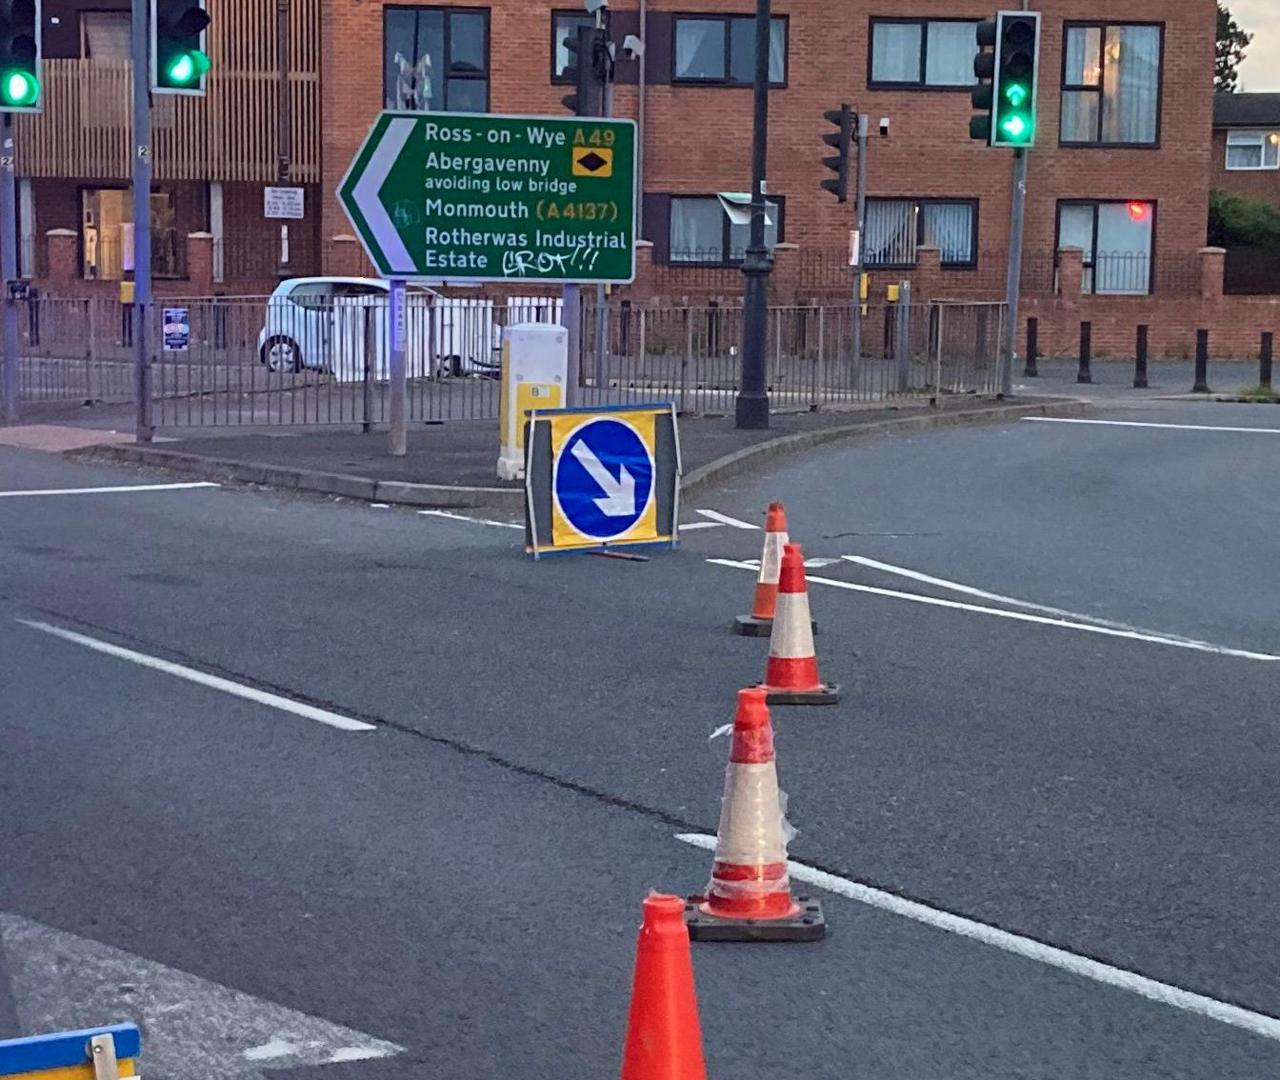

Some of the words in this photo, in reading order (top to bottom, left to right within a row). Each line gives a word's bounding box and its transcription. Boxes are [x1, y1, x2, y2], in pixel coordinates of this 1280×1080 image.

[573, 128, 616, 146] A49
[425, 151, 550, 176] Abergavenny
[424, 176, 490, 193] avoiding
[496, 177, 523, 191] low
[529, 178, 577, 195] bridge
[425, 198, 529, 218] Monmouth
[535, 200, 618, 222] (A4137)
[425, 227, 528, 247] Rotherwas
[536, 229, 626, 249] Industrial
[425, 250, 488, 268] Estate
